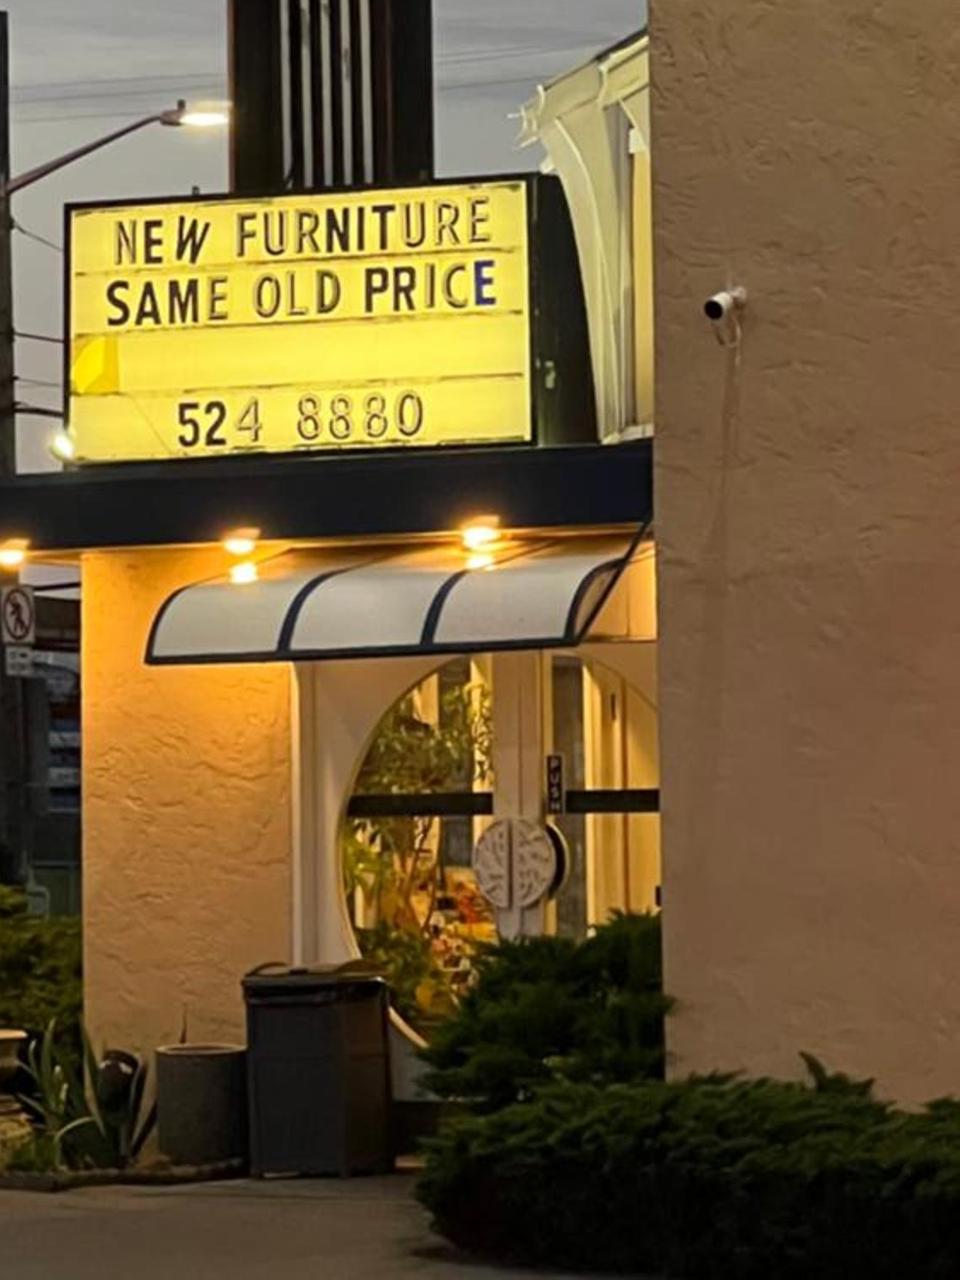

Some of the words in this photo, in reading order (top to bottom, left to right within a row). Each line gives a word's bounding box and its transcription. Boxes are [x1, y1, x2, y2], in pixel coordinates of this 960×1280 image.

[114, 214, 211, 266] NEW
[235, 196, 492, 258] FURNITURE
[106, 275, 230, 327] SAME
[251, 268, 342, 319] OLD
[364, 259, 497, 313] PRICE
[177, 395, 263, 448] 524
[296, 389, 425, 441] 8880
